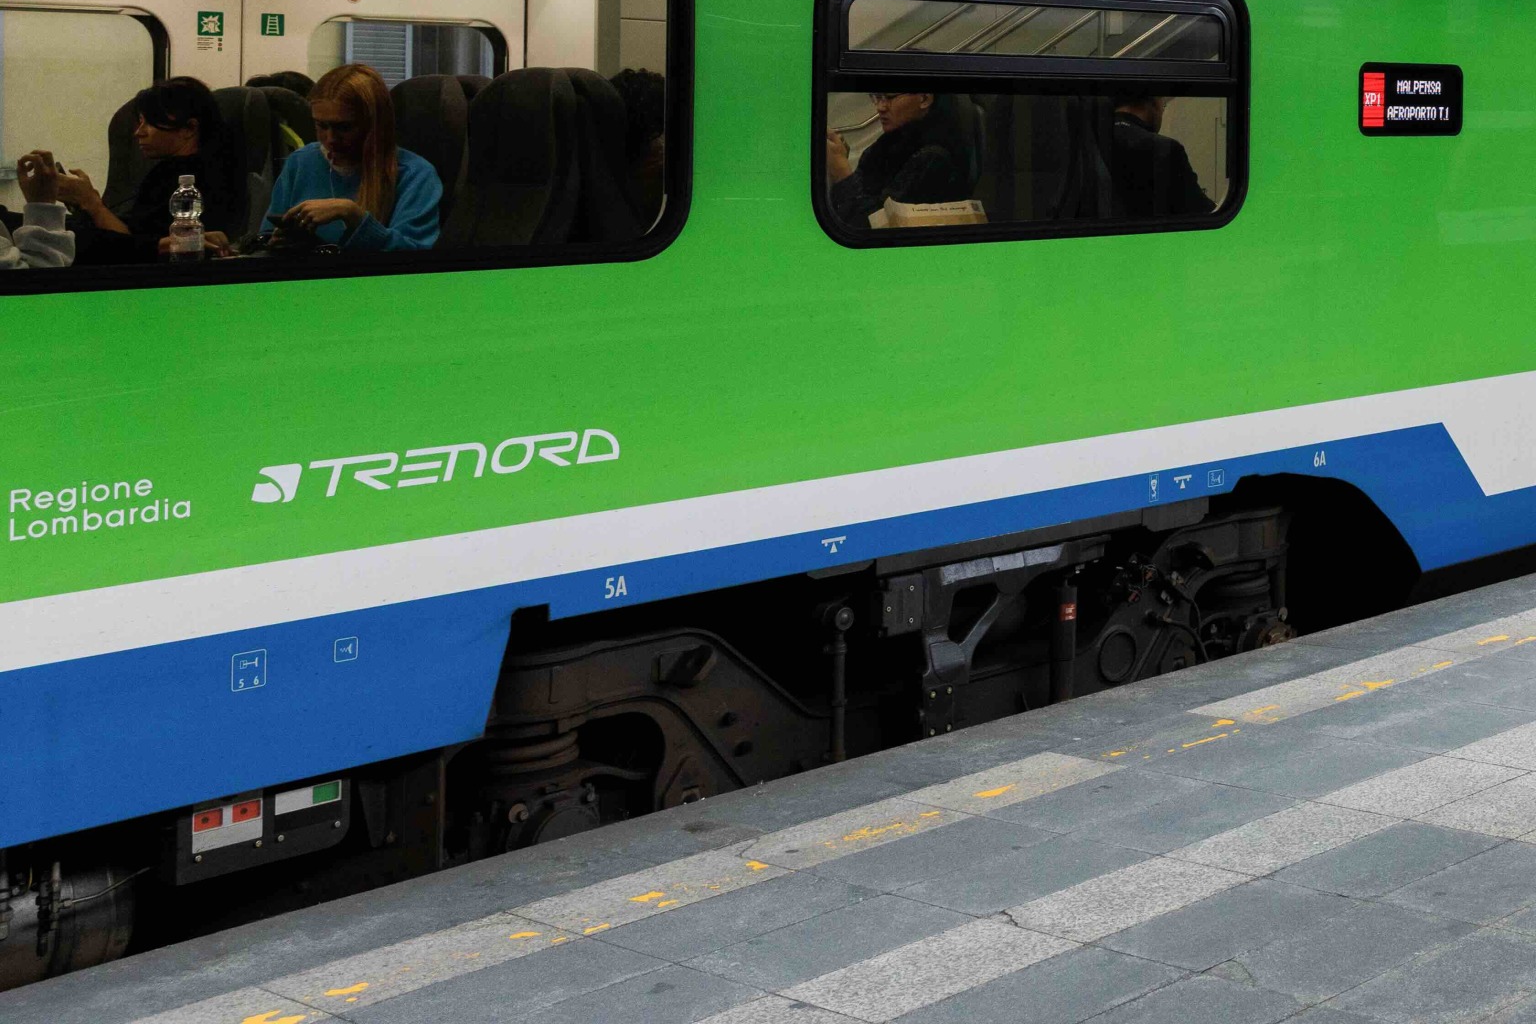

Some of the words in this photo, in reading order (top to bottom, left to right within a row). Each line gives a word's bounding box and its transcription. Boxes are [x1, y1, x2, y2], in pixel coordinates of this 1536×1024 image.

[1396, 79, 1442, 95] MALPENSA
[1364, 92, 1382, 106] XP1
[1387, 105, 1437, 121] AEROPORTO
[308, 428, 621, 498] TRENORD
[1313, 450, 1327, 468] 6A
[10, 479, 153, 513] Regione
[10, 498, 191, 542] Lombardia
[604, 575, 628, 599] 5A
